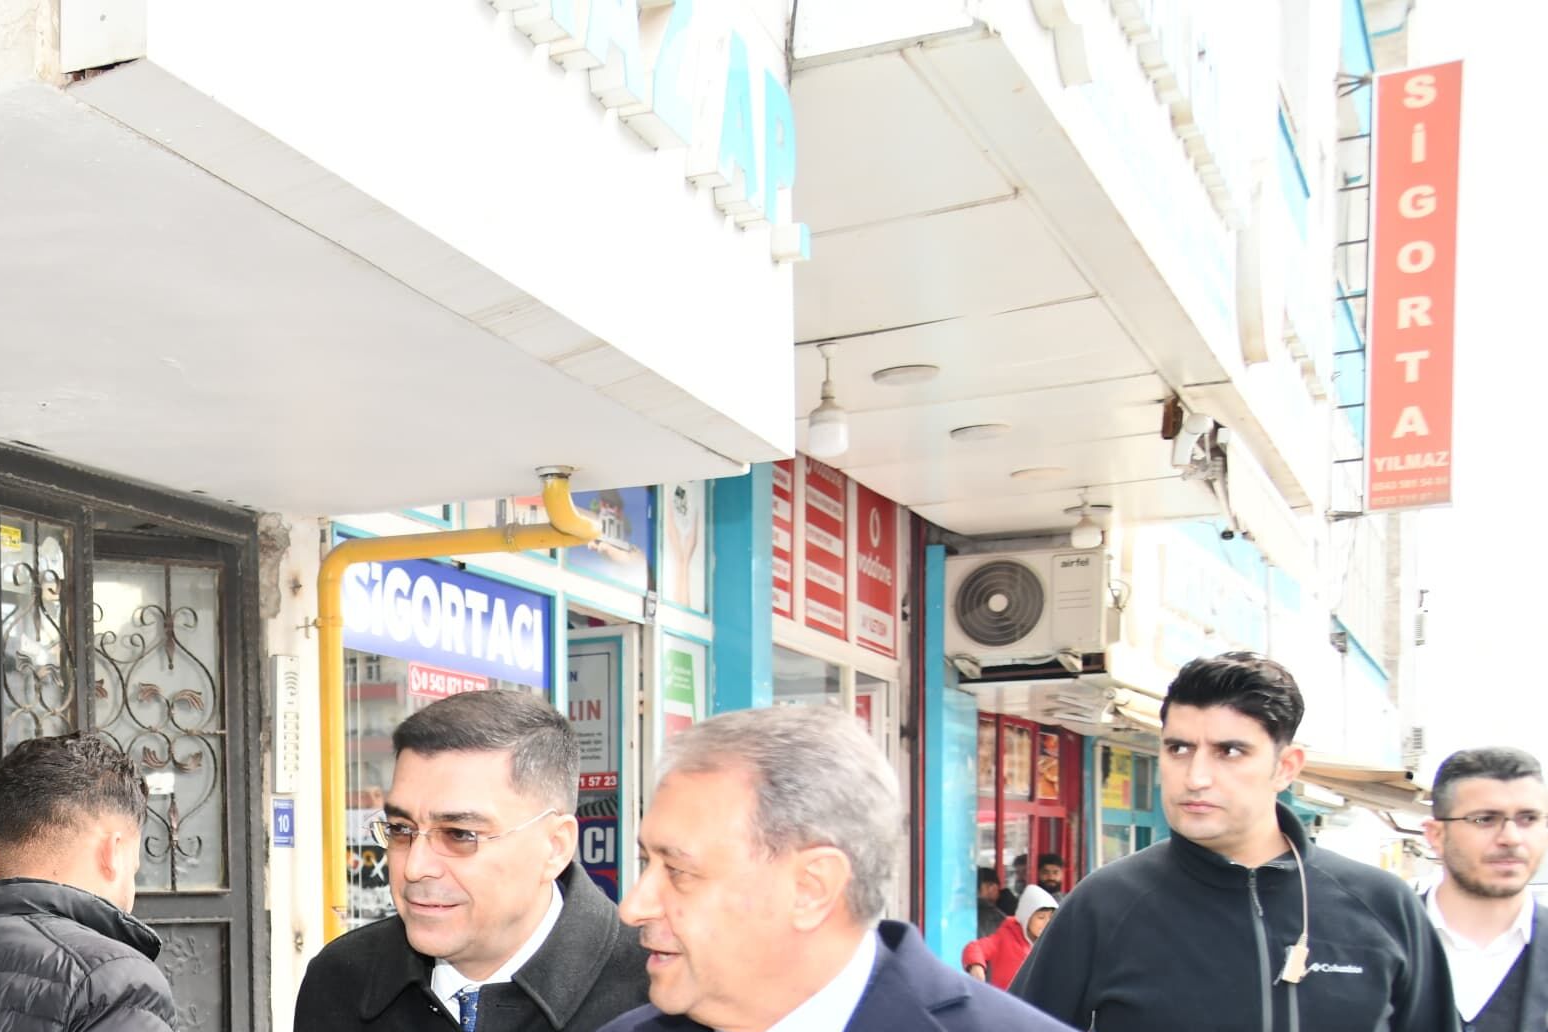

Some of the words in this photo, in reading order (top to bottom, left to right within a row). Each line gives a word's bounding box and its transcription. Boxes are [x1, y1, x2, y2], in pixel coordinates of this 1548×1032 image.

[1374, 451, 1449, 473] YILMAZ
[569, 699, 601, 722] LIN
[277, 813, 291, 833] 10
